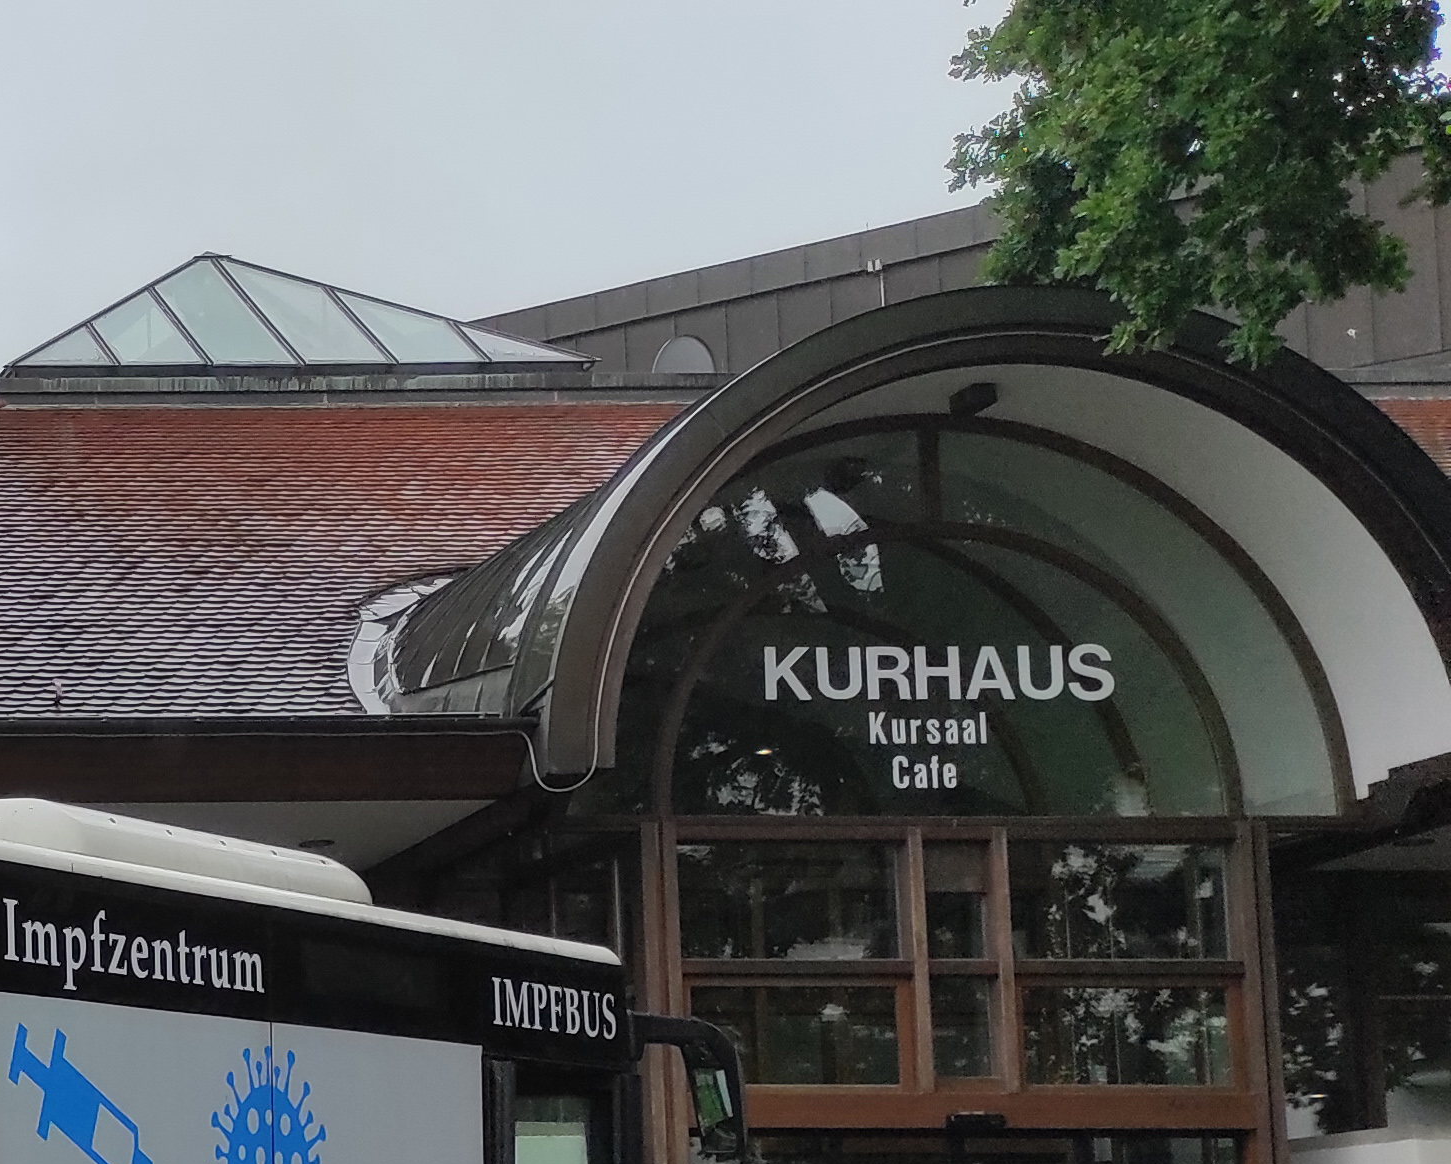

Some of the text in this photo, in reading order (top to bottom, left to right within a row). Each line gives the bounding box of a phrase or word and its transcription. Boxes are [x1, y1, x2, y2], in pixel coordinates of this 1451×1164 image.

[763, 643, 1116, 701] KURHAUS
[868, 711, 988, 745] Kursaal
[891, 755, 958, 789] Cafe
[3, 898, 265, 993] Impfzentrum
[491, 977, 617, 1040] IMPFBUS
